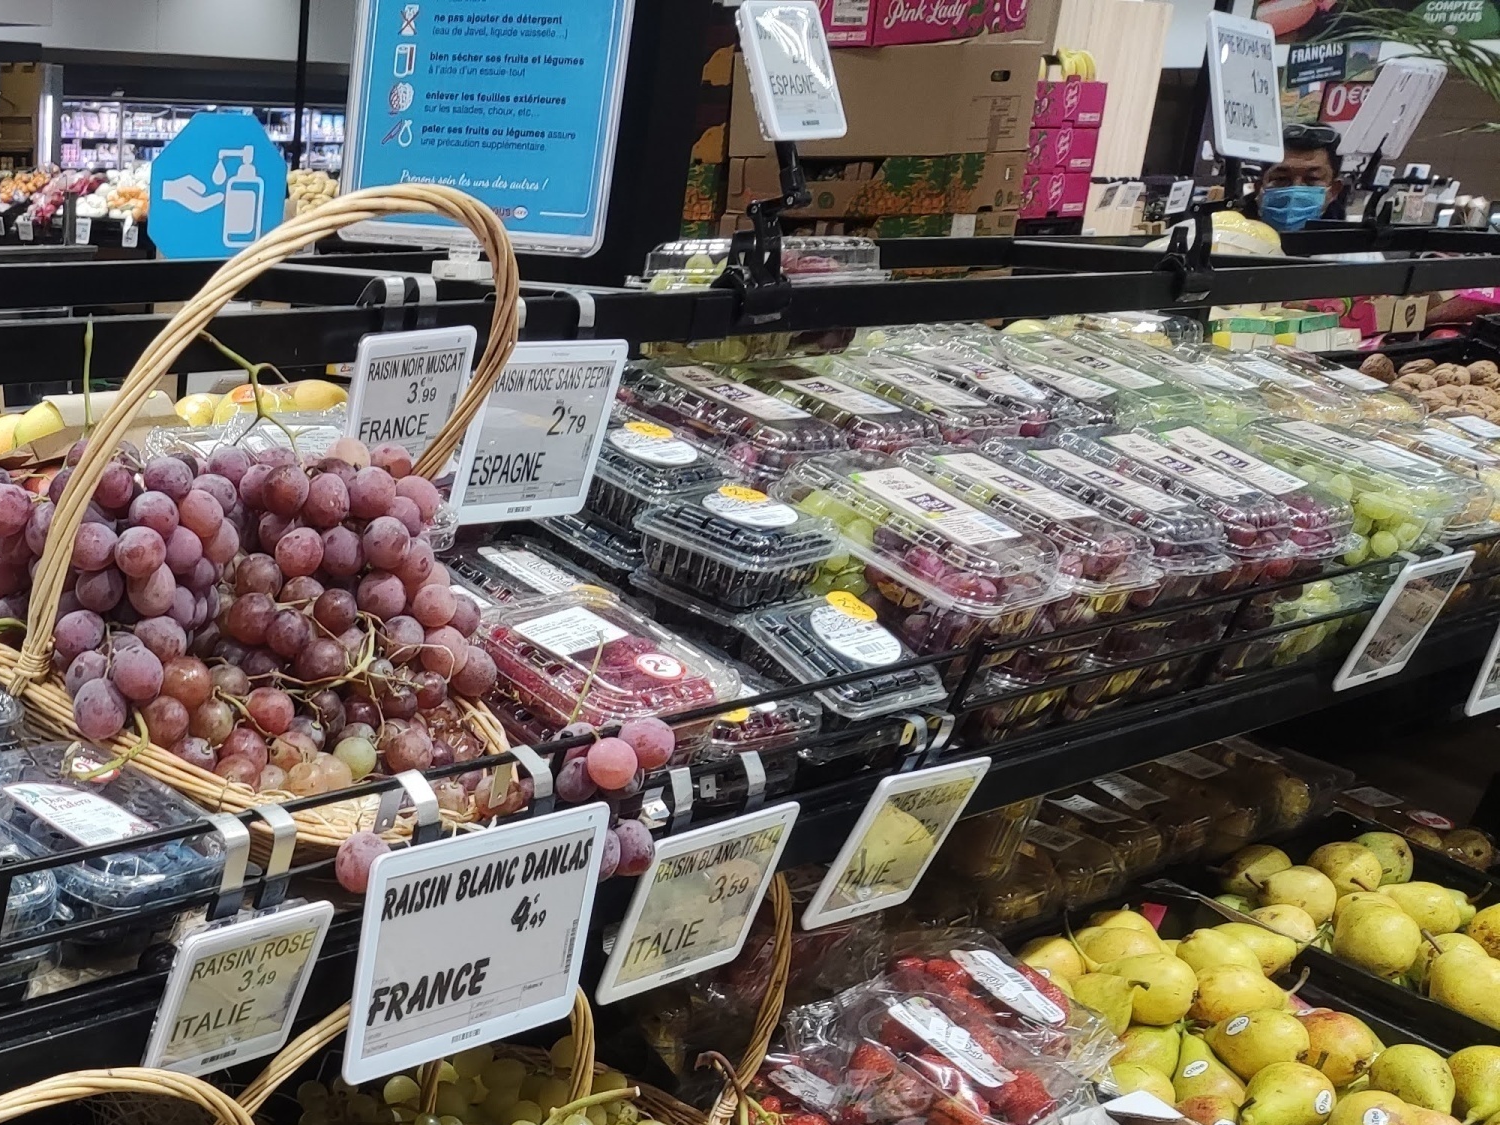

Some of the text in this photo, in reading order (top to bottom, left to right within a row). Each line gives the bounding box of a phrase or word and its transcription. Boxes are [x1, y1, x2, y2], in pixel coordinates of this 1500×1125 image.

[517, 14, 563, 26] détergent
[883, 0, 968, 30] Pink Lady
[1426, 0, 1484, 11] COMPTEZ
[1449, 12, 1482, 22] NOUS
[1291, 42, 1344, 64] FRANÇAIS
[769, 73, 818, 95] ESPAGNE
[507, 127, 545, 139] légumes
[509, 178, 539, 191] autres
[367, 351, 465, 382] RAISIN NOIR MUSCAT
[529, 368, 555, 391] ROSE
[555, 366, 583, 389] SANS
[584, 364, 614, 389] PEPIN
[358, 413, 430, 442] FRANCE
[468, 451, 546, 487] ESPAGNE
[653, 855, 699, 885] RAISIN
[697, 839, 741, 871] BLANC
[381, 837, 594, 922] RAISIN BLANC DANLAS
[190, 930, 316, 982] RAISIN ROSE
[622, 918, 705, 969] ITALIE
[366, 957, 491, 1026] FRANCE
[171, 998, 256, 1043] ITALIE
